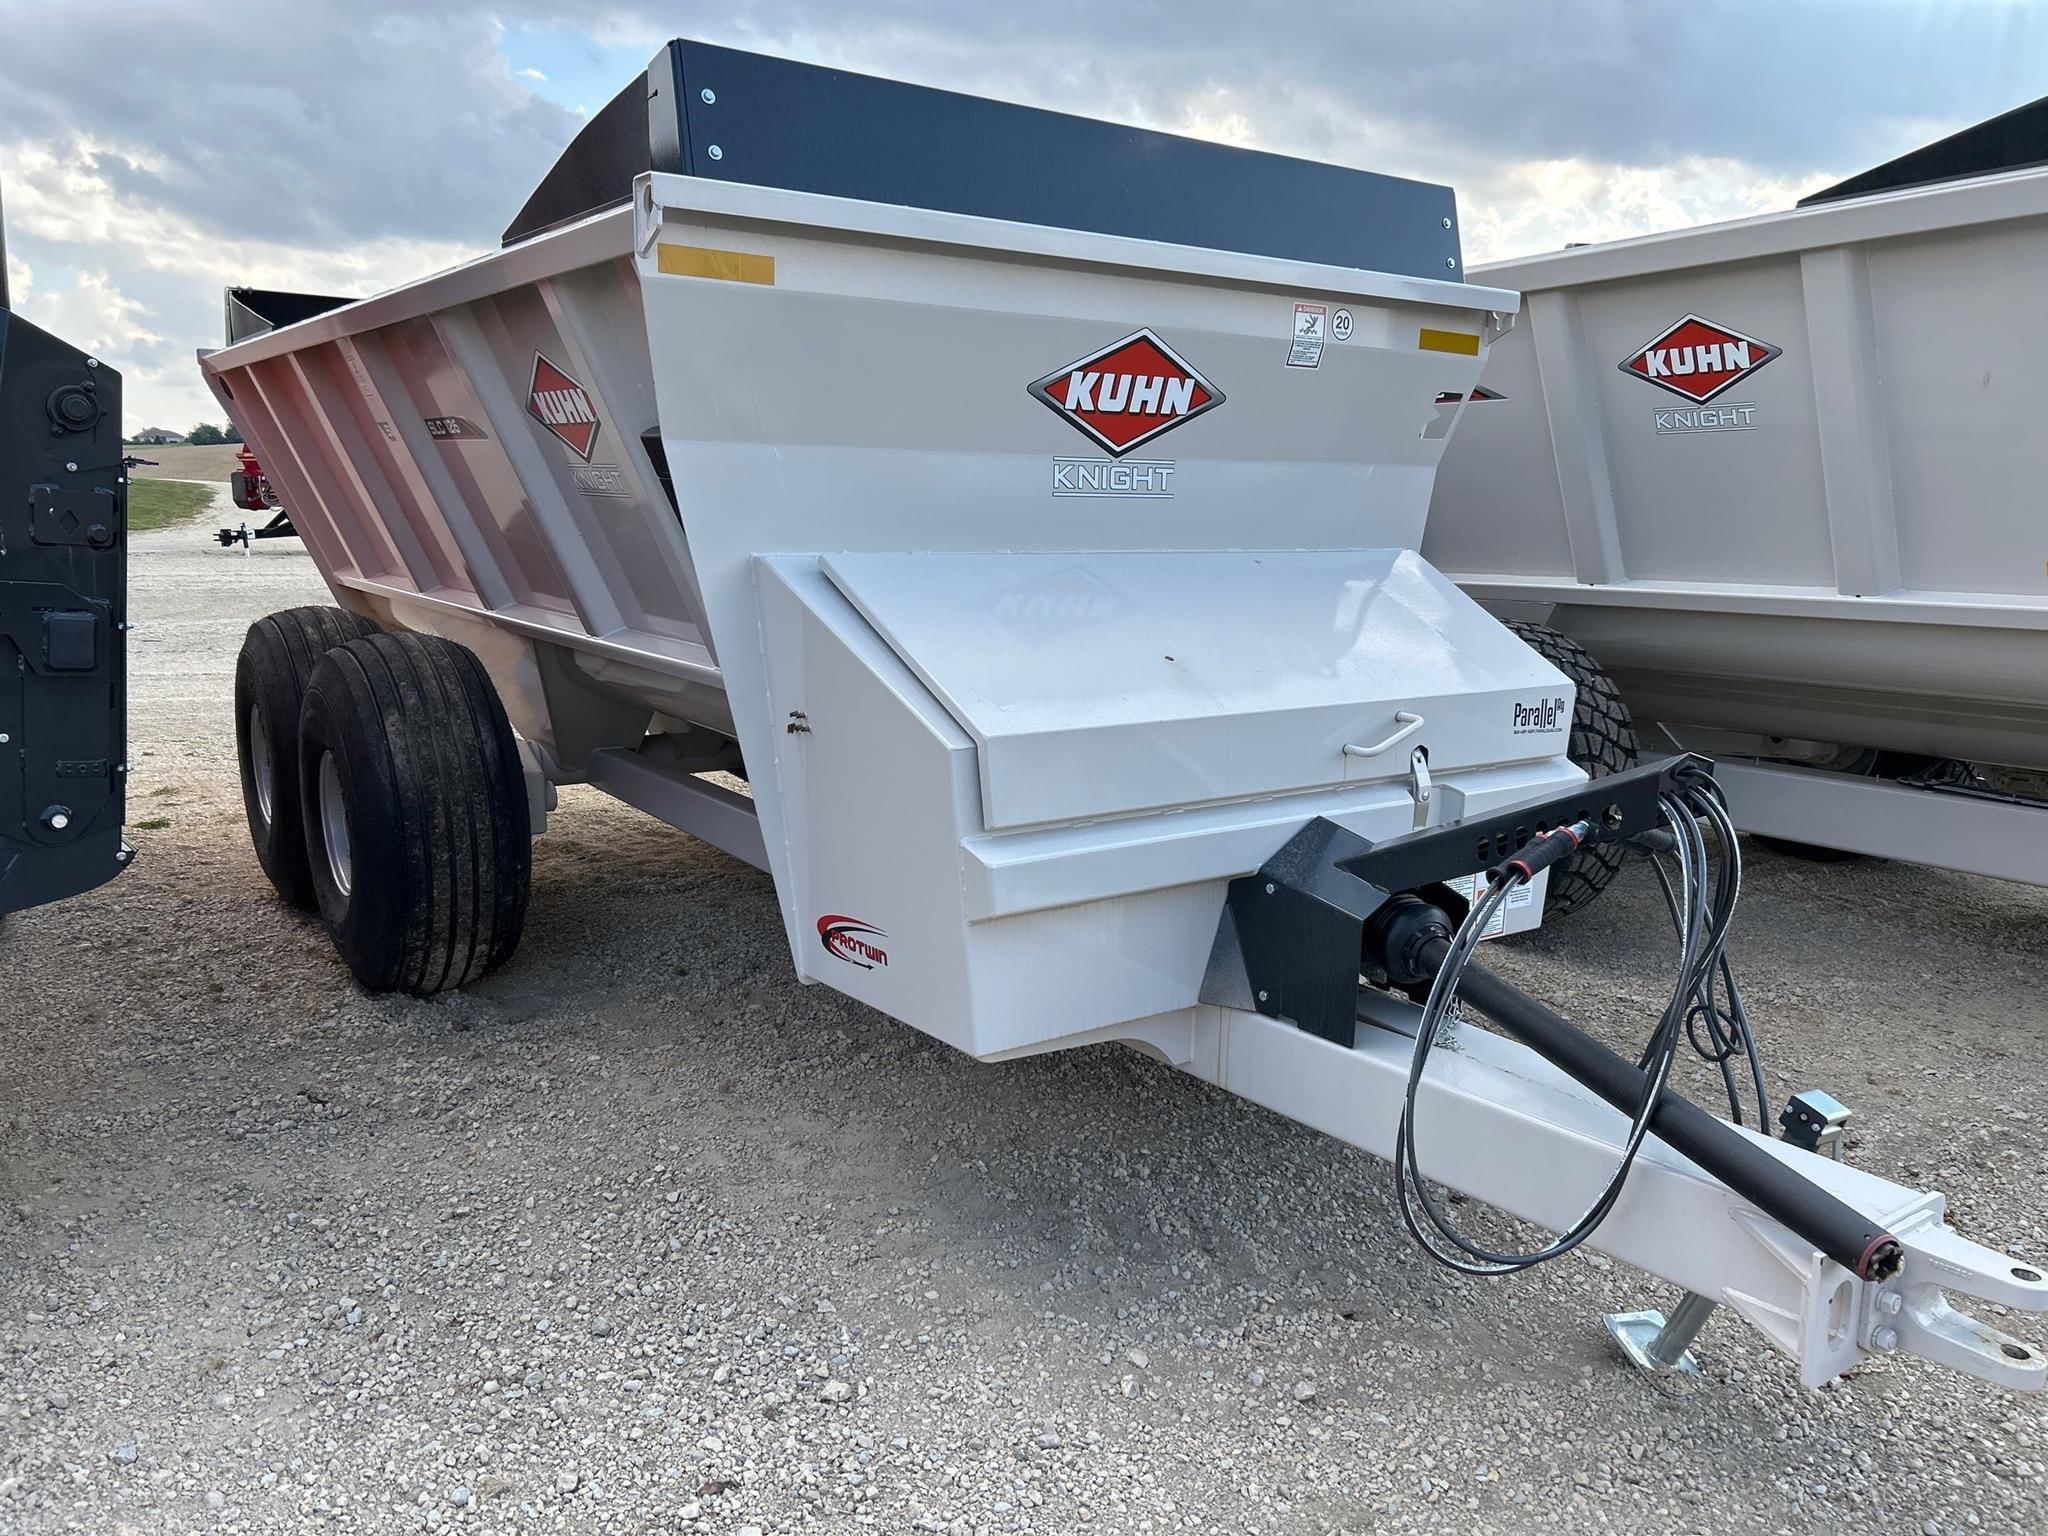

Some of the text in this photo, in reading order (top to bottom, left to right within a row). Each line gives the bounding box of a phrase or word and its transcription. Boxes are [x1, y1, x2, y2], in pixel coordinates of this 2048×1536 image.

[1335, 315, 1350, 330] 20
[1645, 341, 1751, 377] KUHN
[533, 388, 595, 424] KUHN
[1064, 371, 1196, 415] KUHN
[1654, 408, 1756, 430] KNIGHT
[569, 471, 624, 491] KNIGHT
[1052, 464, 1175, 491] KNIGHT
